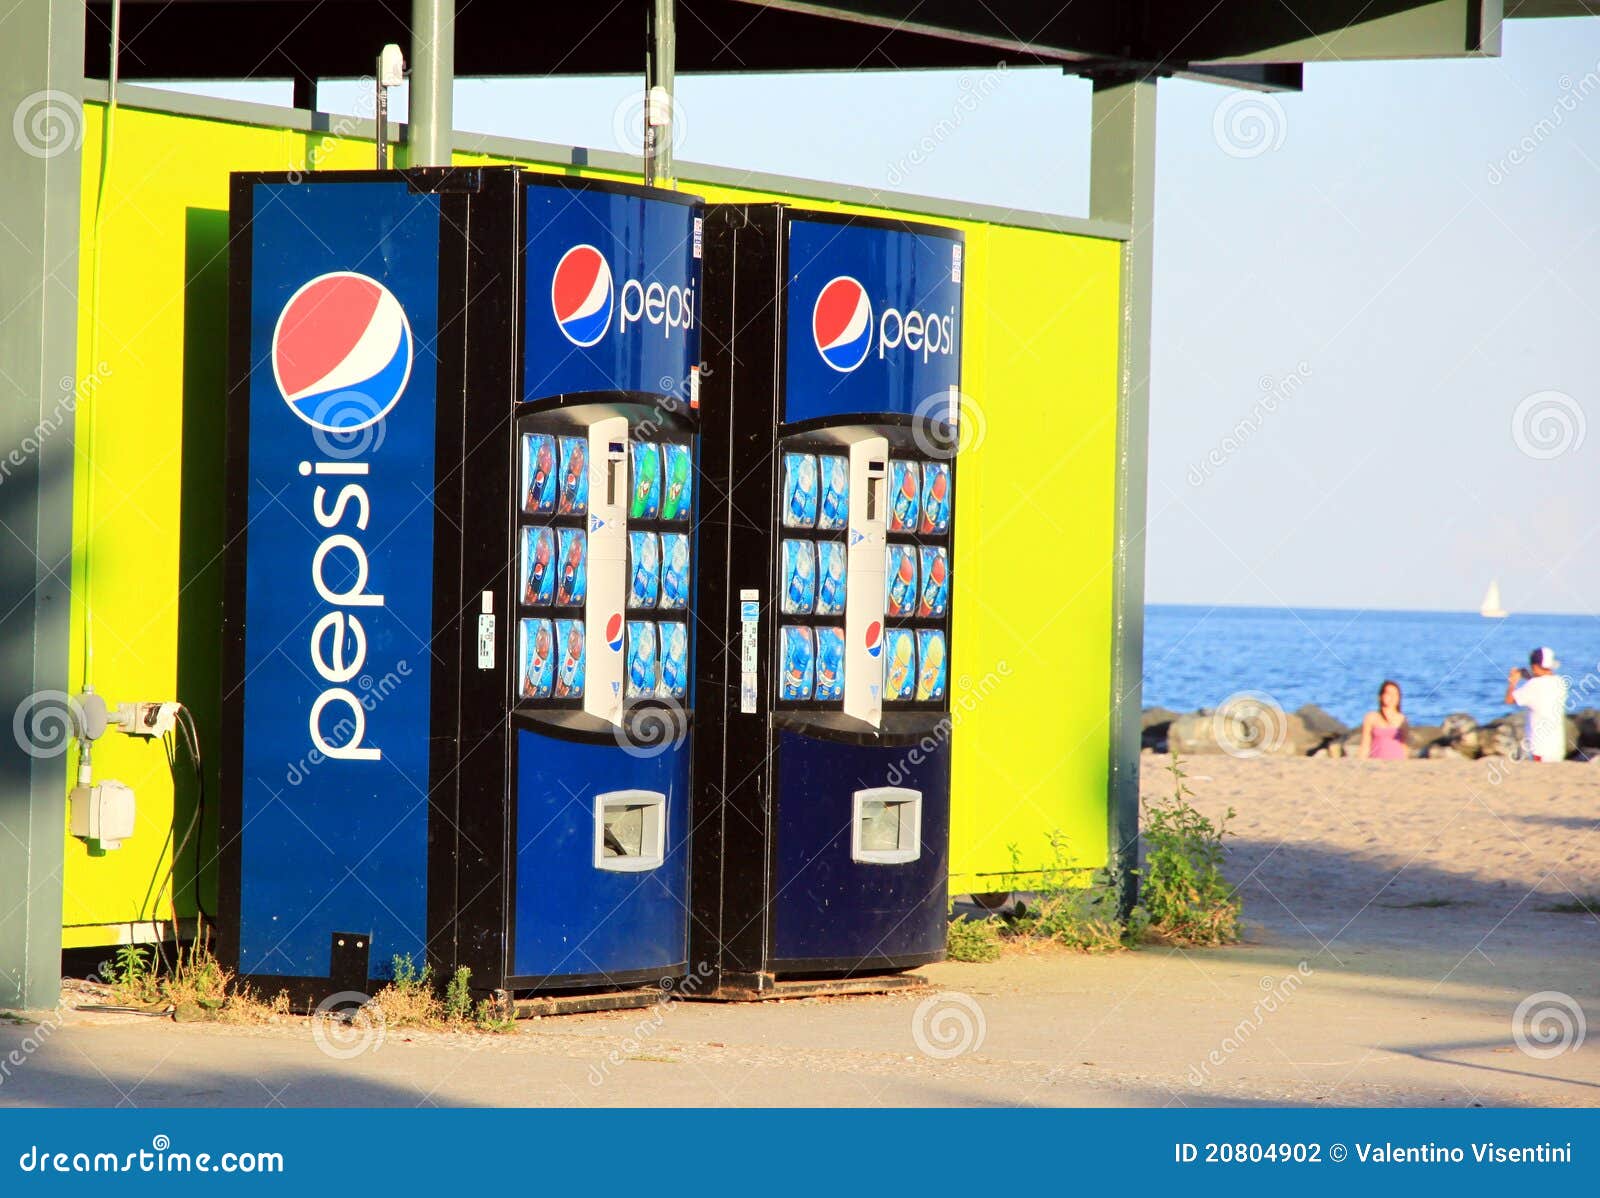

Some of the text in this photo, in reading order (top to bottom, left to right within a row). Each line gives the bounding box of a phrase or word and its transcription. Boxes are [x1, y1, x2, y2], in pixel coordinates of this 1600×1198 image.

[620, 277, 695, 339] pepsi
[879, 305, 955, 364] pepsi
[298, 460, 385, 761] pepsi
